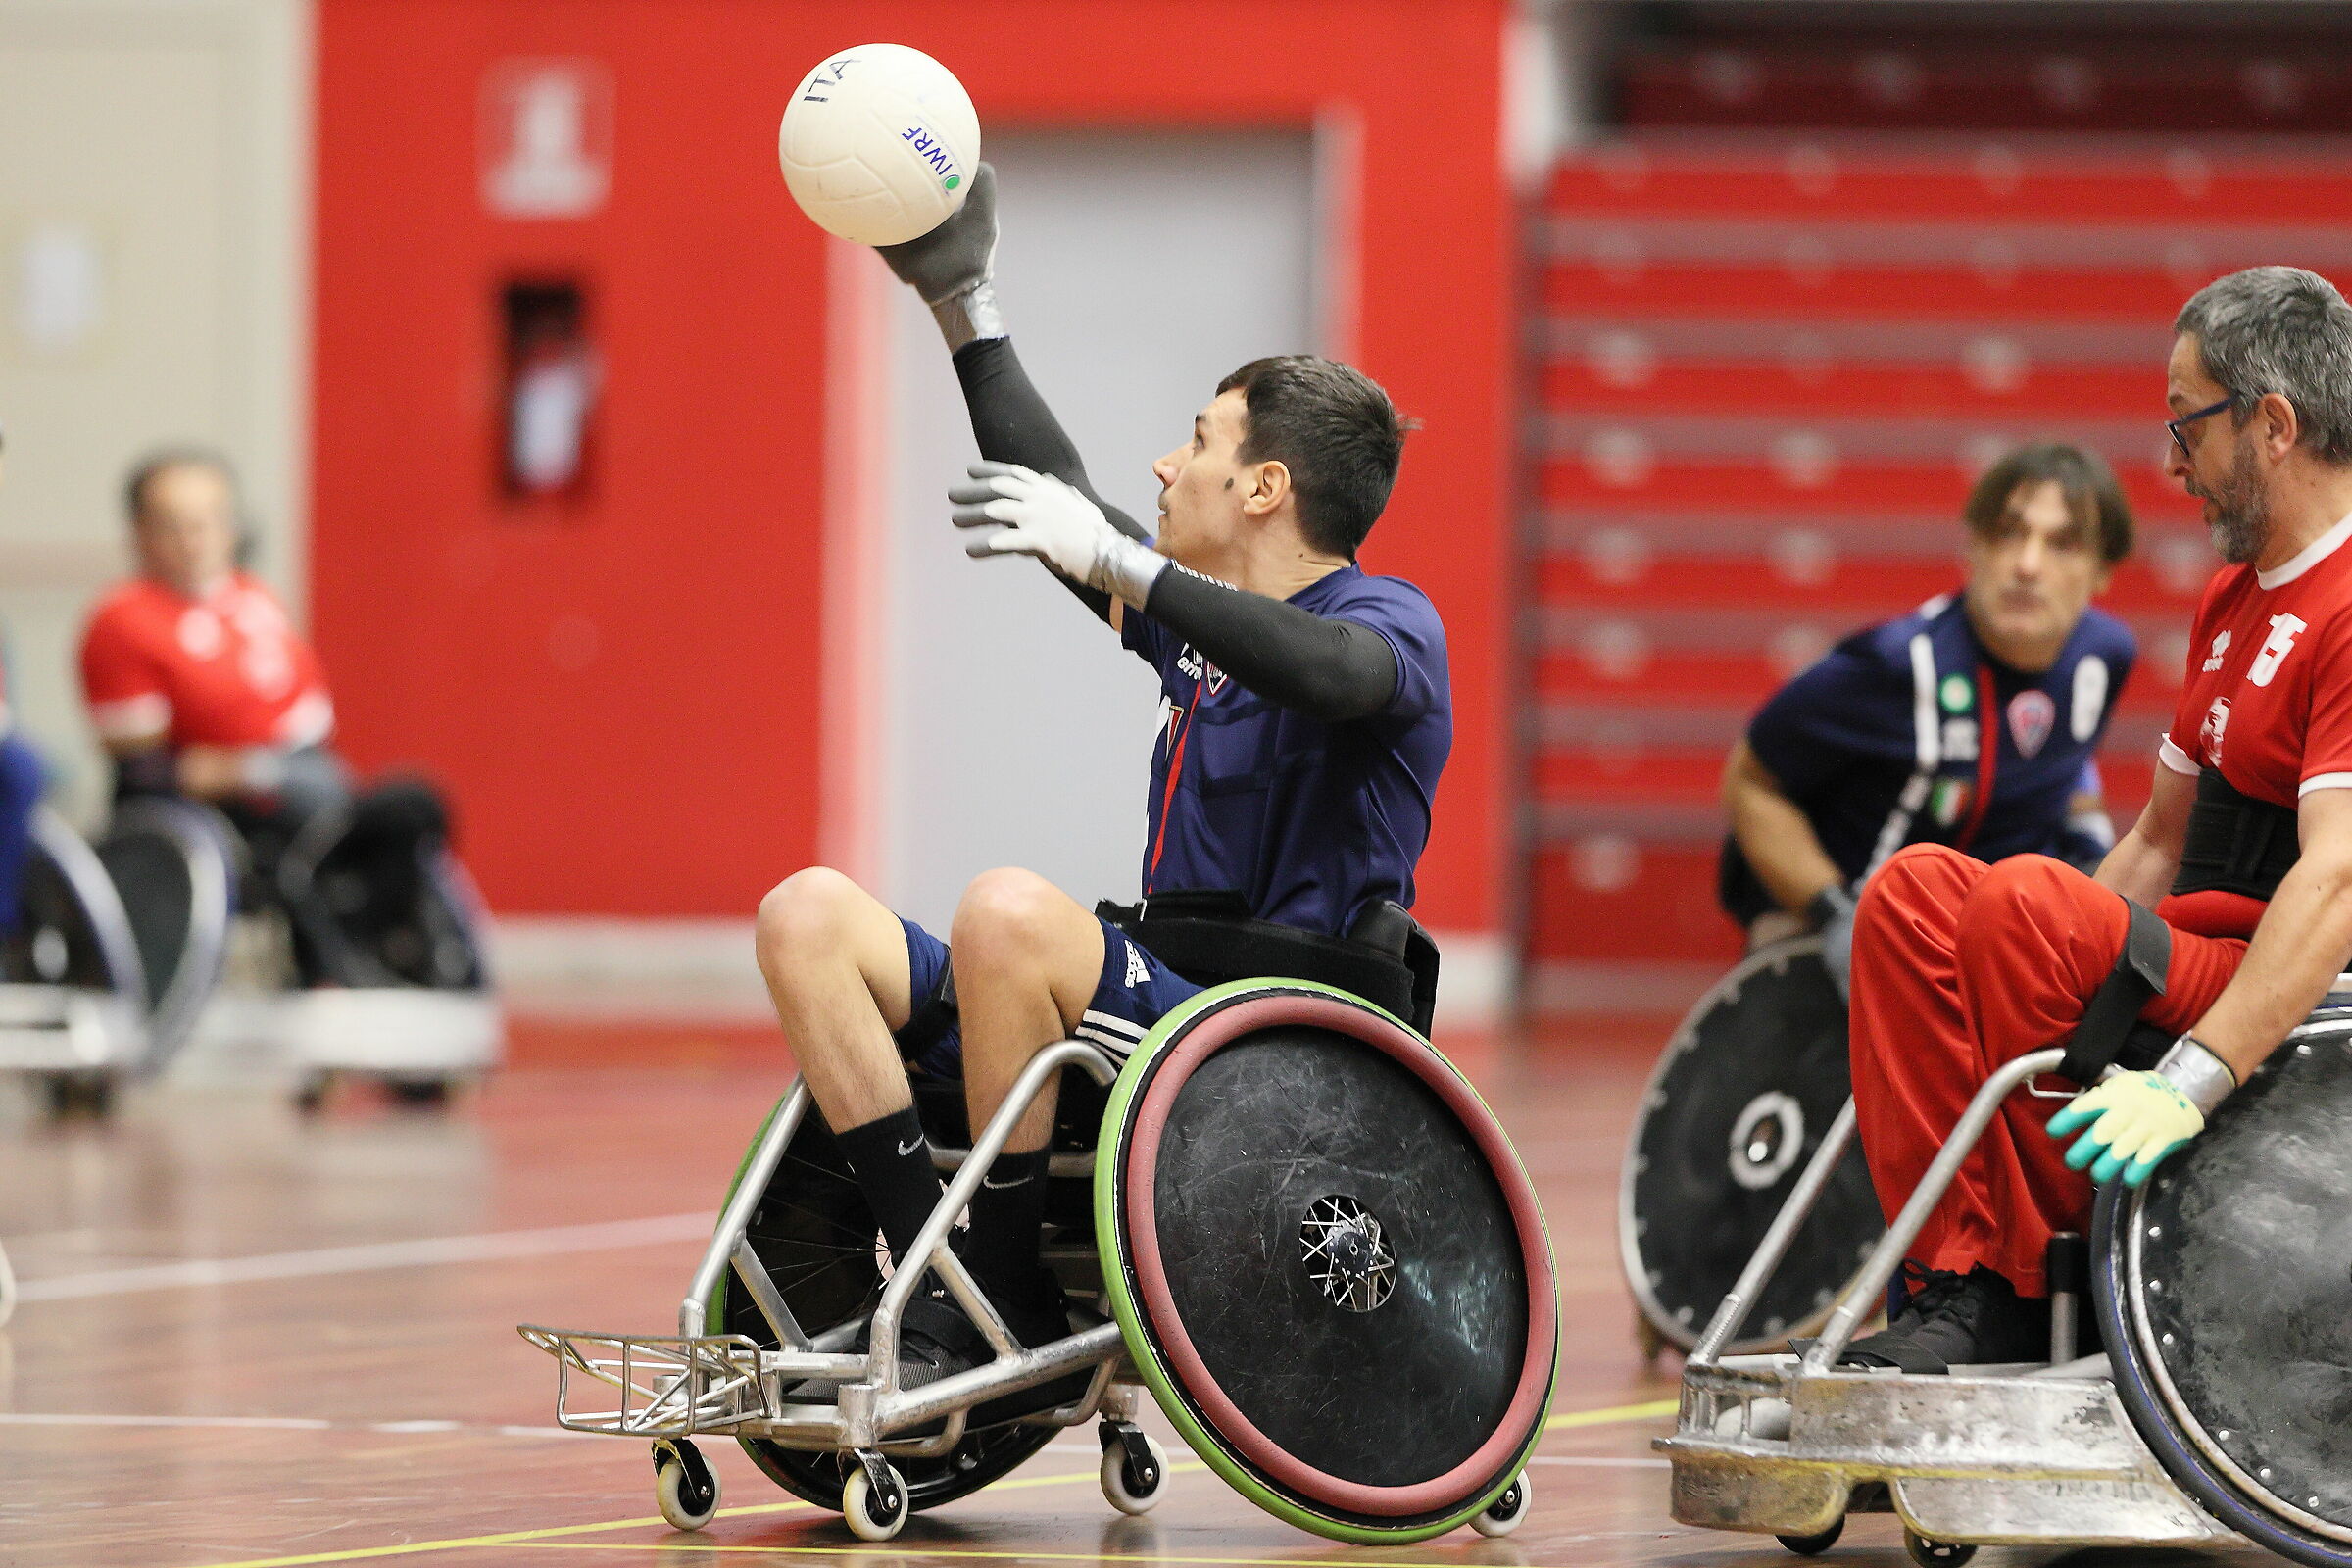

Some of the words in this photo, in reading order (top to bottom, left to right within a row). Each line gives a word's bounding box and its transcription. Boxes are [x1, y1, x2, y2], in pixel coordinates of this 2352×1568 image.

[804, 59, 861, 102] ITA
[902, 127, 953, 175] IWRF
[2246, 612, 2308, 687] 15
